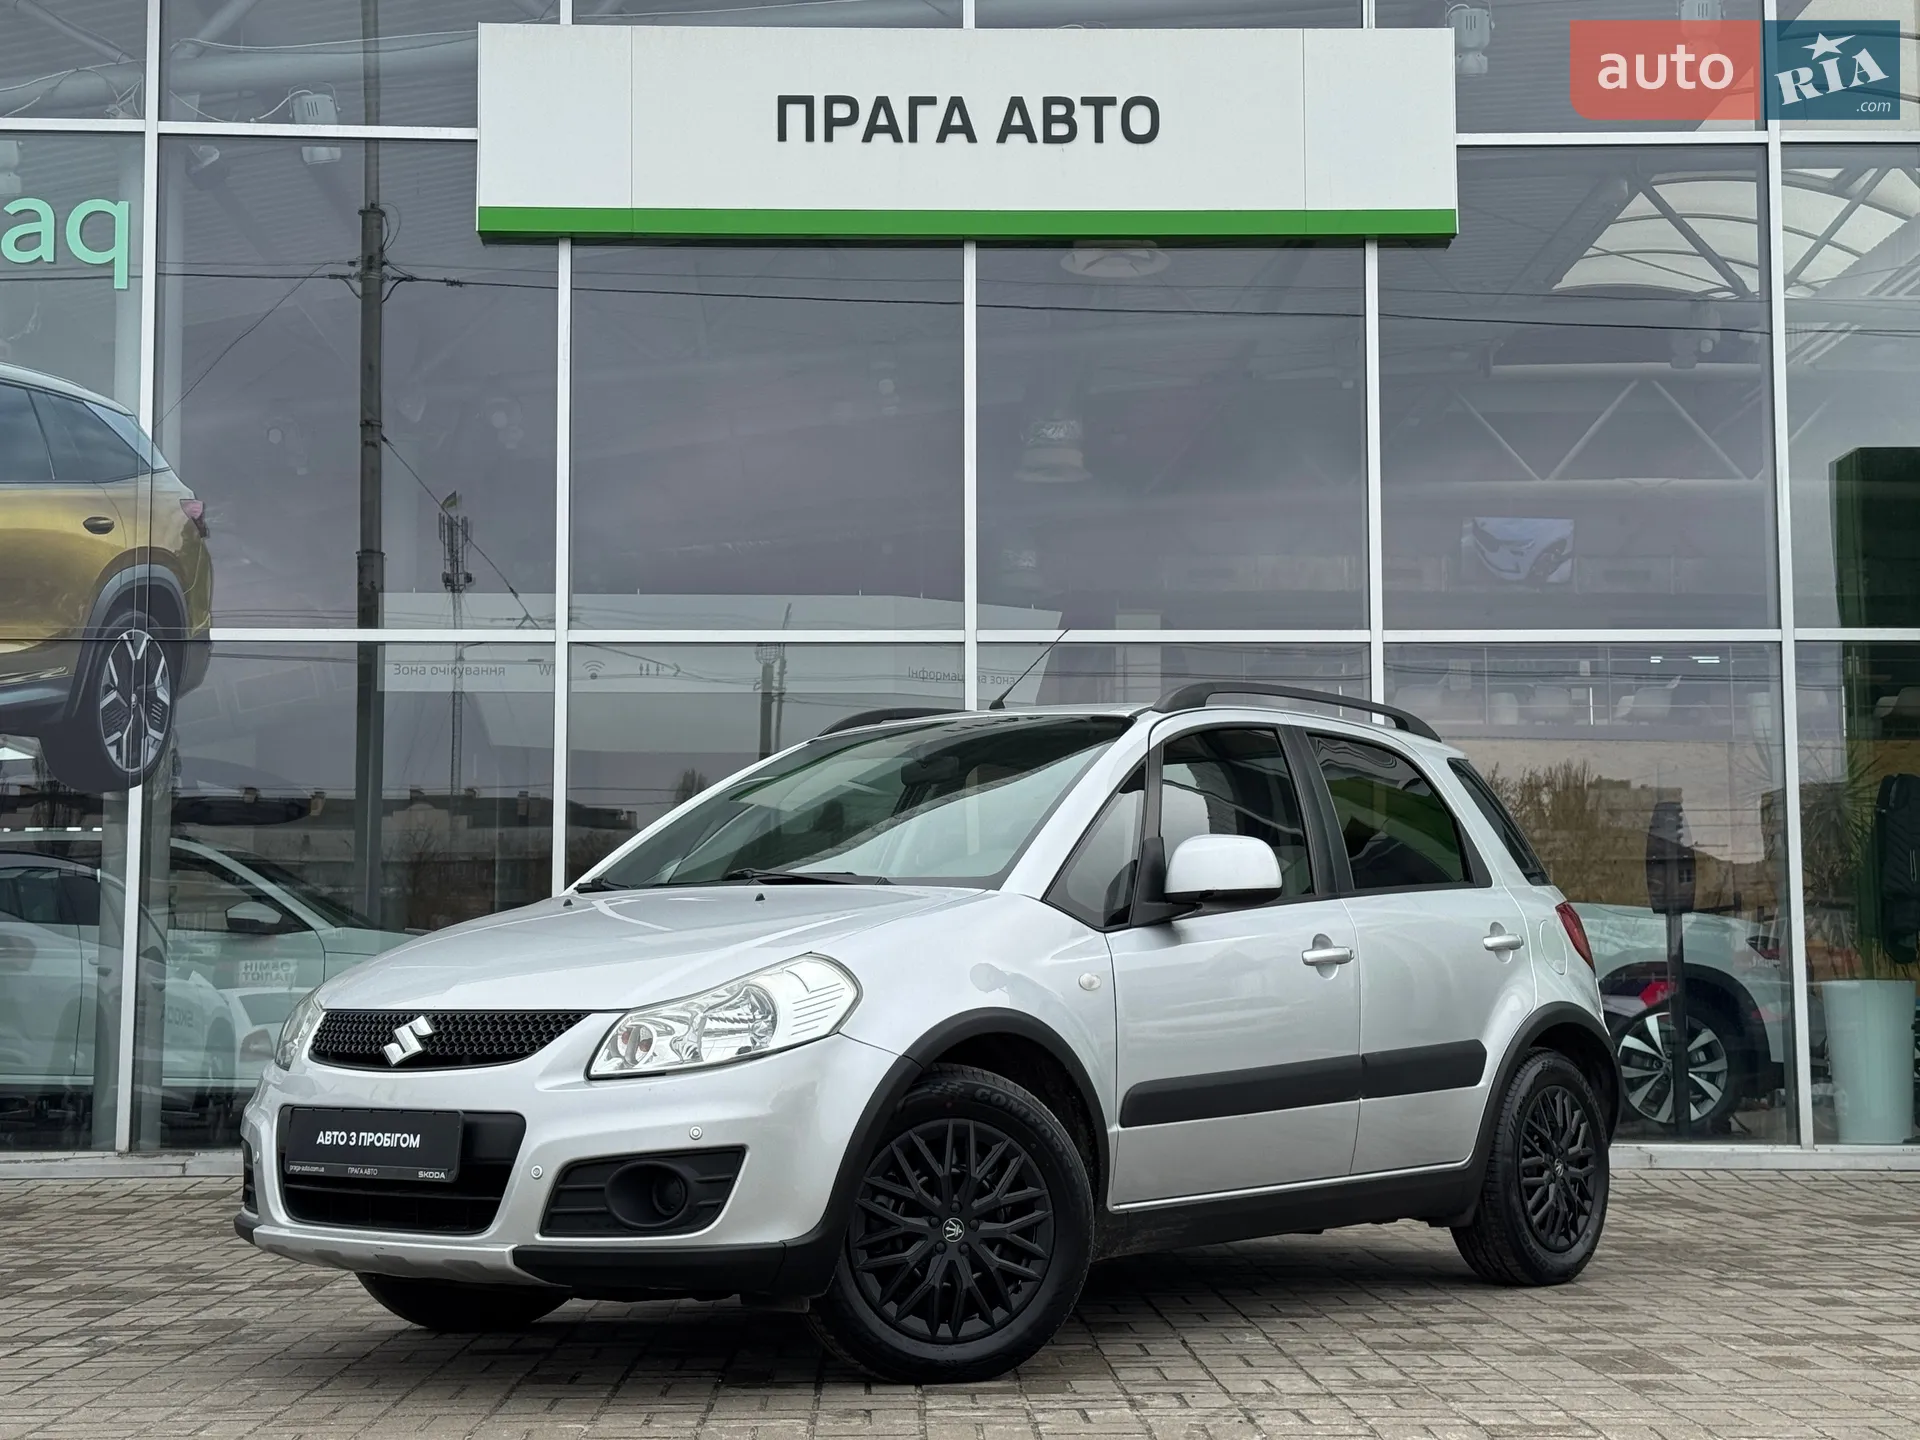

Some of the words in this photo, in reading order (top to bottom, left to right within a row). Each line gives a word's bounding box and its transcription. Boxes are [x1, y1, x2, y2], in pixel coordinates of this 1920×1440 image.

[778, 95, 978, 144] ПРАГА
[996, 95, 1160, 145] АВТО
[393, 663, 427, 676] Зона
[430, 663, 506, 679] очікування
[316, 1131, 347, 1146] АВТО
[358, 1131, 421, 1148] ПРОБІГОМ
[364, 1168, 378, 1176] АВТО
